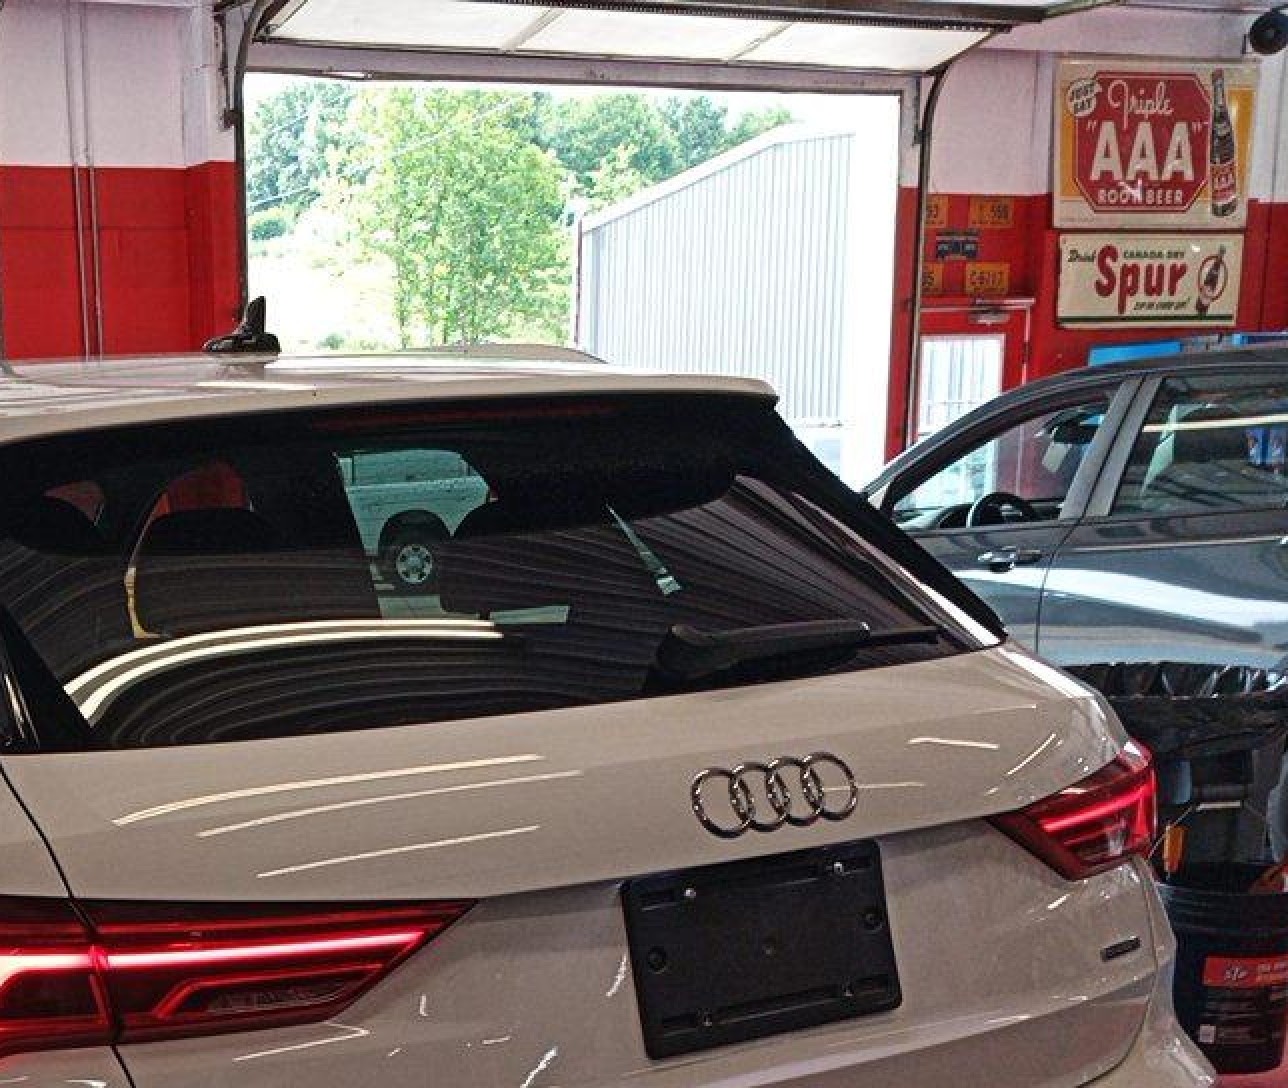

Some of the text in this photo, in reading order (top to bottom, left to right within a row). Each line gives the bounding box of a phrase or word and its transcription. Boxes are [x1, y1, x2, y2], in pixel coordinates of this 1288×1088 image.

[1108, 79, 1174, 130] Triple
[1145, 189, 1183, 204] BEER
[1095, 245, 1187, 315] Spur
